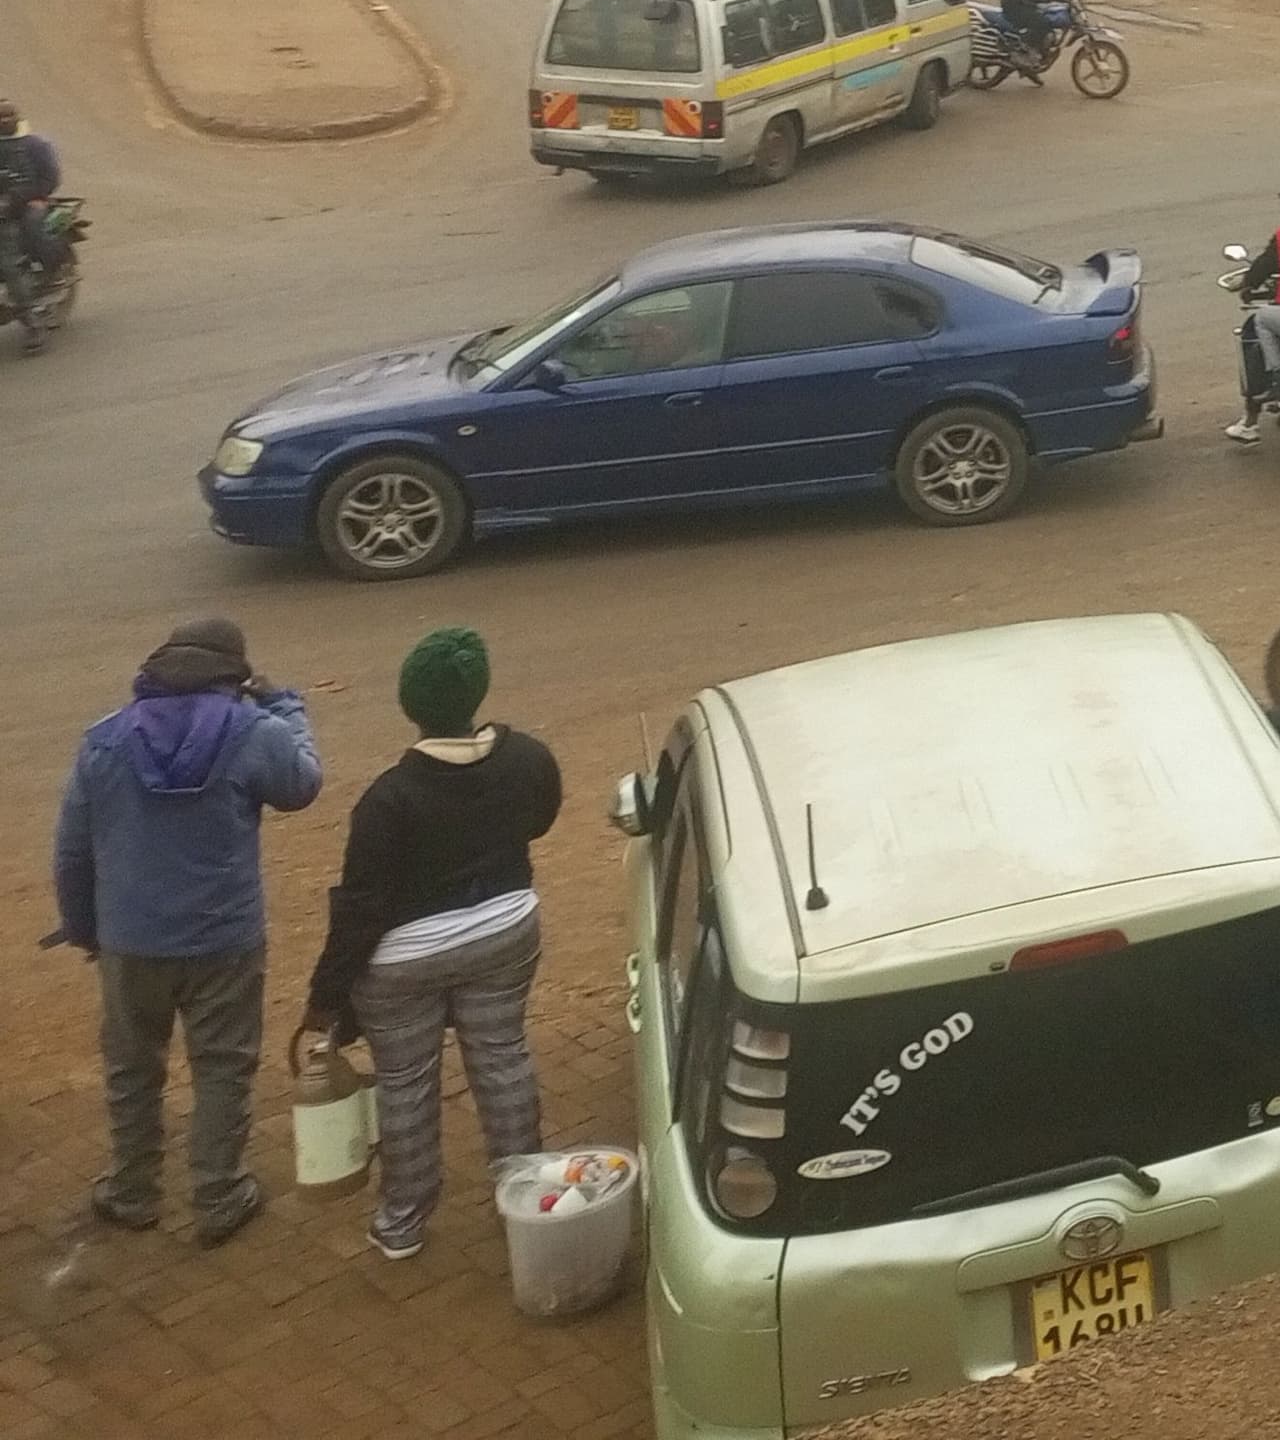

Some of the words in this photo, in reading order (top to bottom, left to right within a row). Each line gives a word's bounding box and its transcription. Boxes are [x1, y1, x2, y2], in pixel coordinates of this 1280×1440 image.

[840, 1069, 901, 1136] IT'S
[900, 1012, 974, 1071] GOD
[1061, 1255, 1145, 1315] KCF
[818, 1367, 911, 1399] SIENTA
